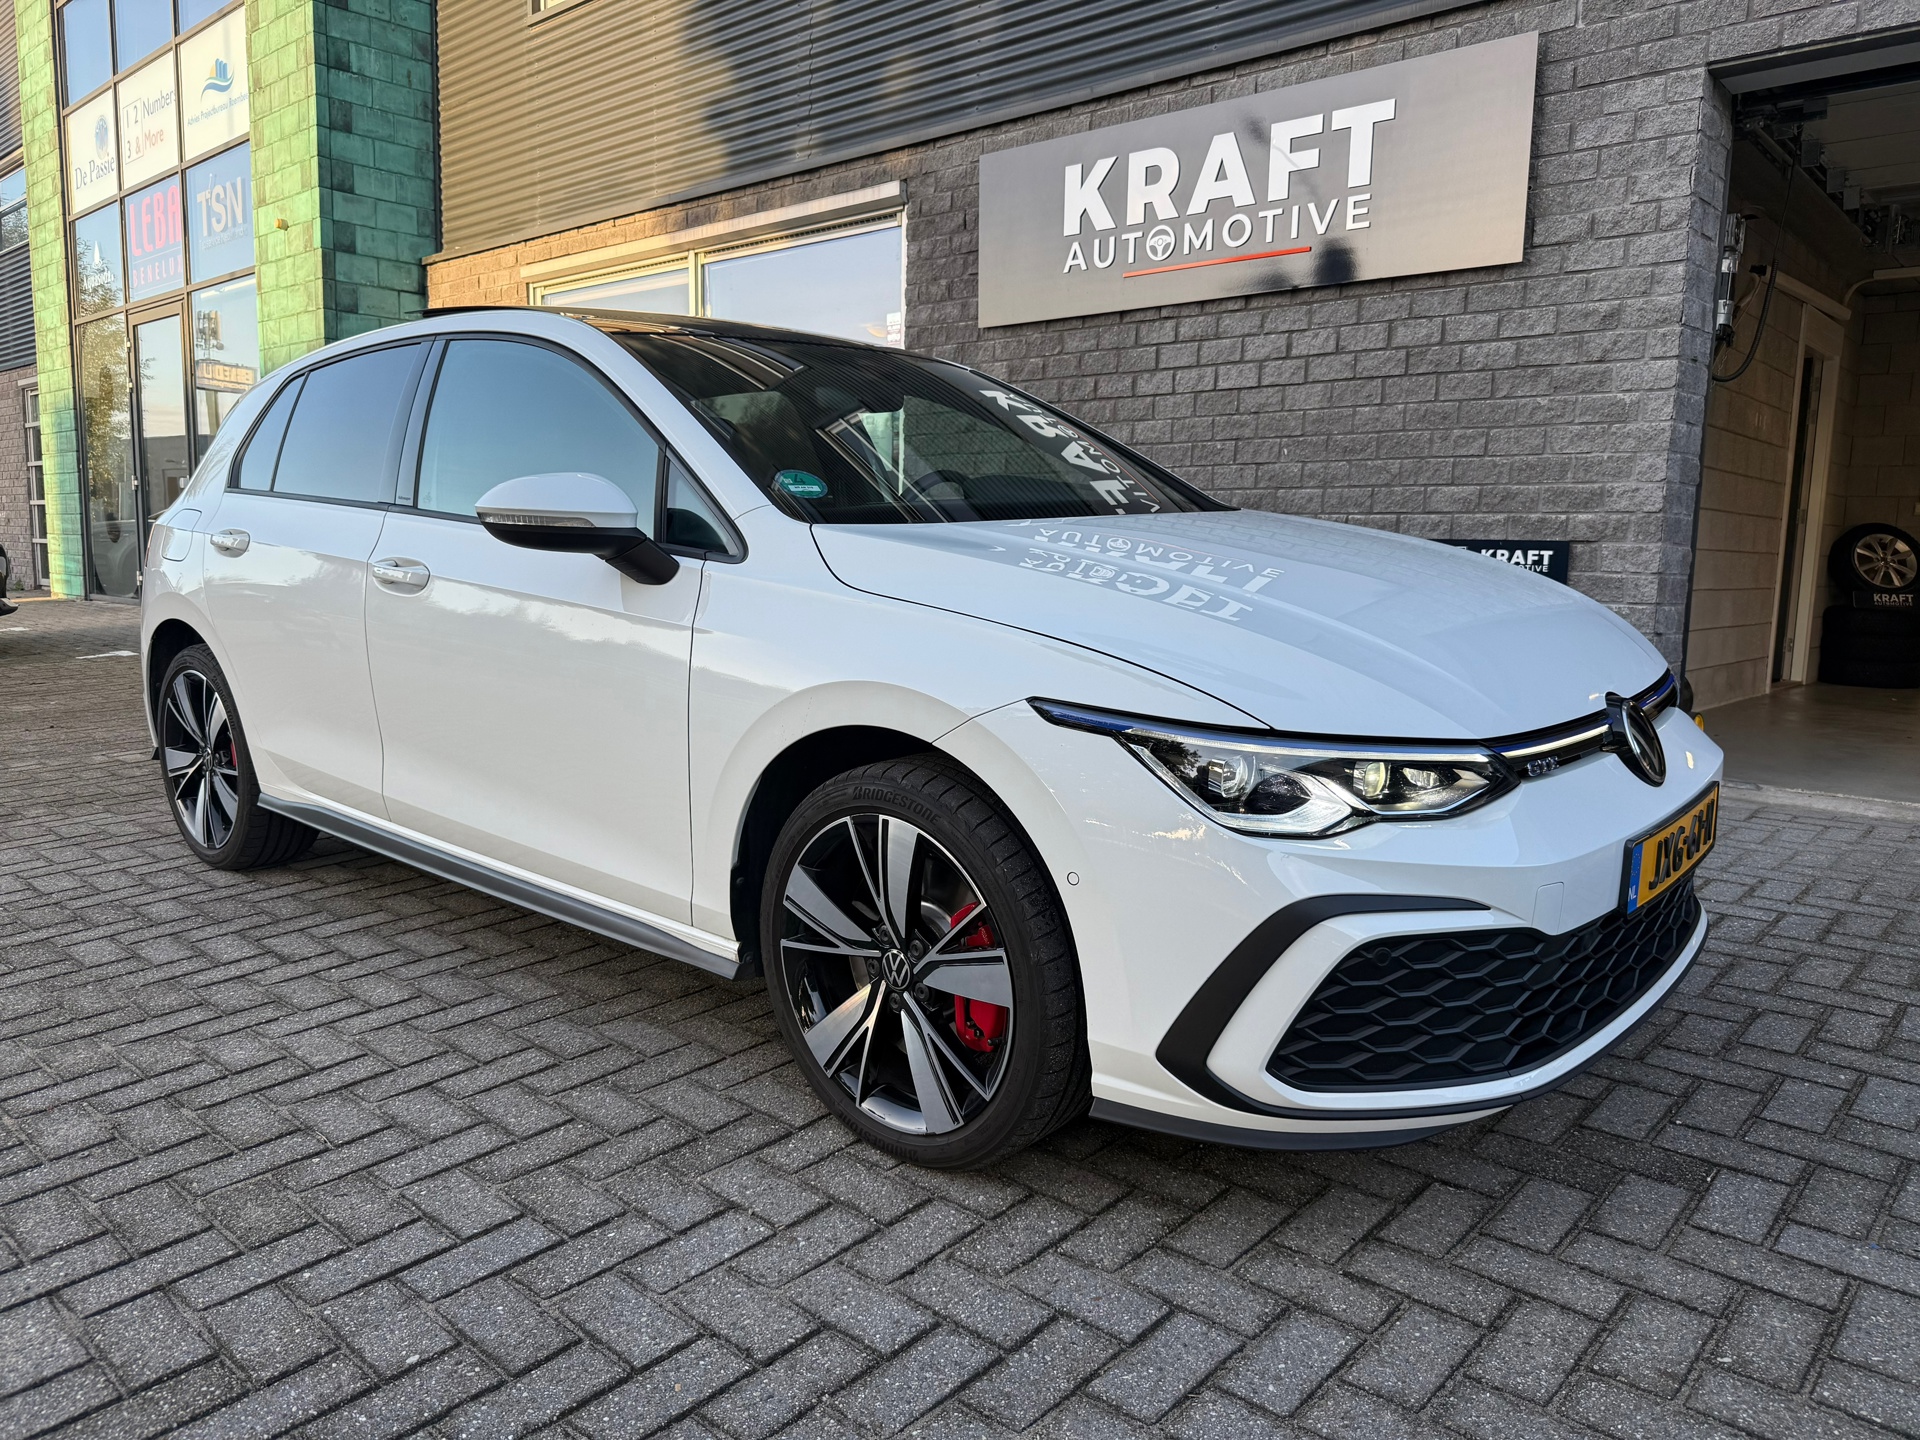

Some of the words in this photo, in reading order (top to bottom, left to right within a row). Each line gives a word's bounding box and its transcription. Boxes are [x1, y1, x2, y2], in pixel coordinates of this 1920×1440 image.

[144, 129, 164, 150] More
[75, 167, 88, 190] De
[89, 152, 115, 183] Passie
[1063, 98, 1396, 237] KRAFT
[129, 184, 182, 257] LEBA
[1062, 193, 1372, 274] AUTOMOTIVE
[133, 255, 183, 288] BENELUX
[1873, 593, 1914, 602] KRAFT
[852, 786, 942, 825] BRIDGESTONE
